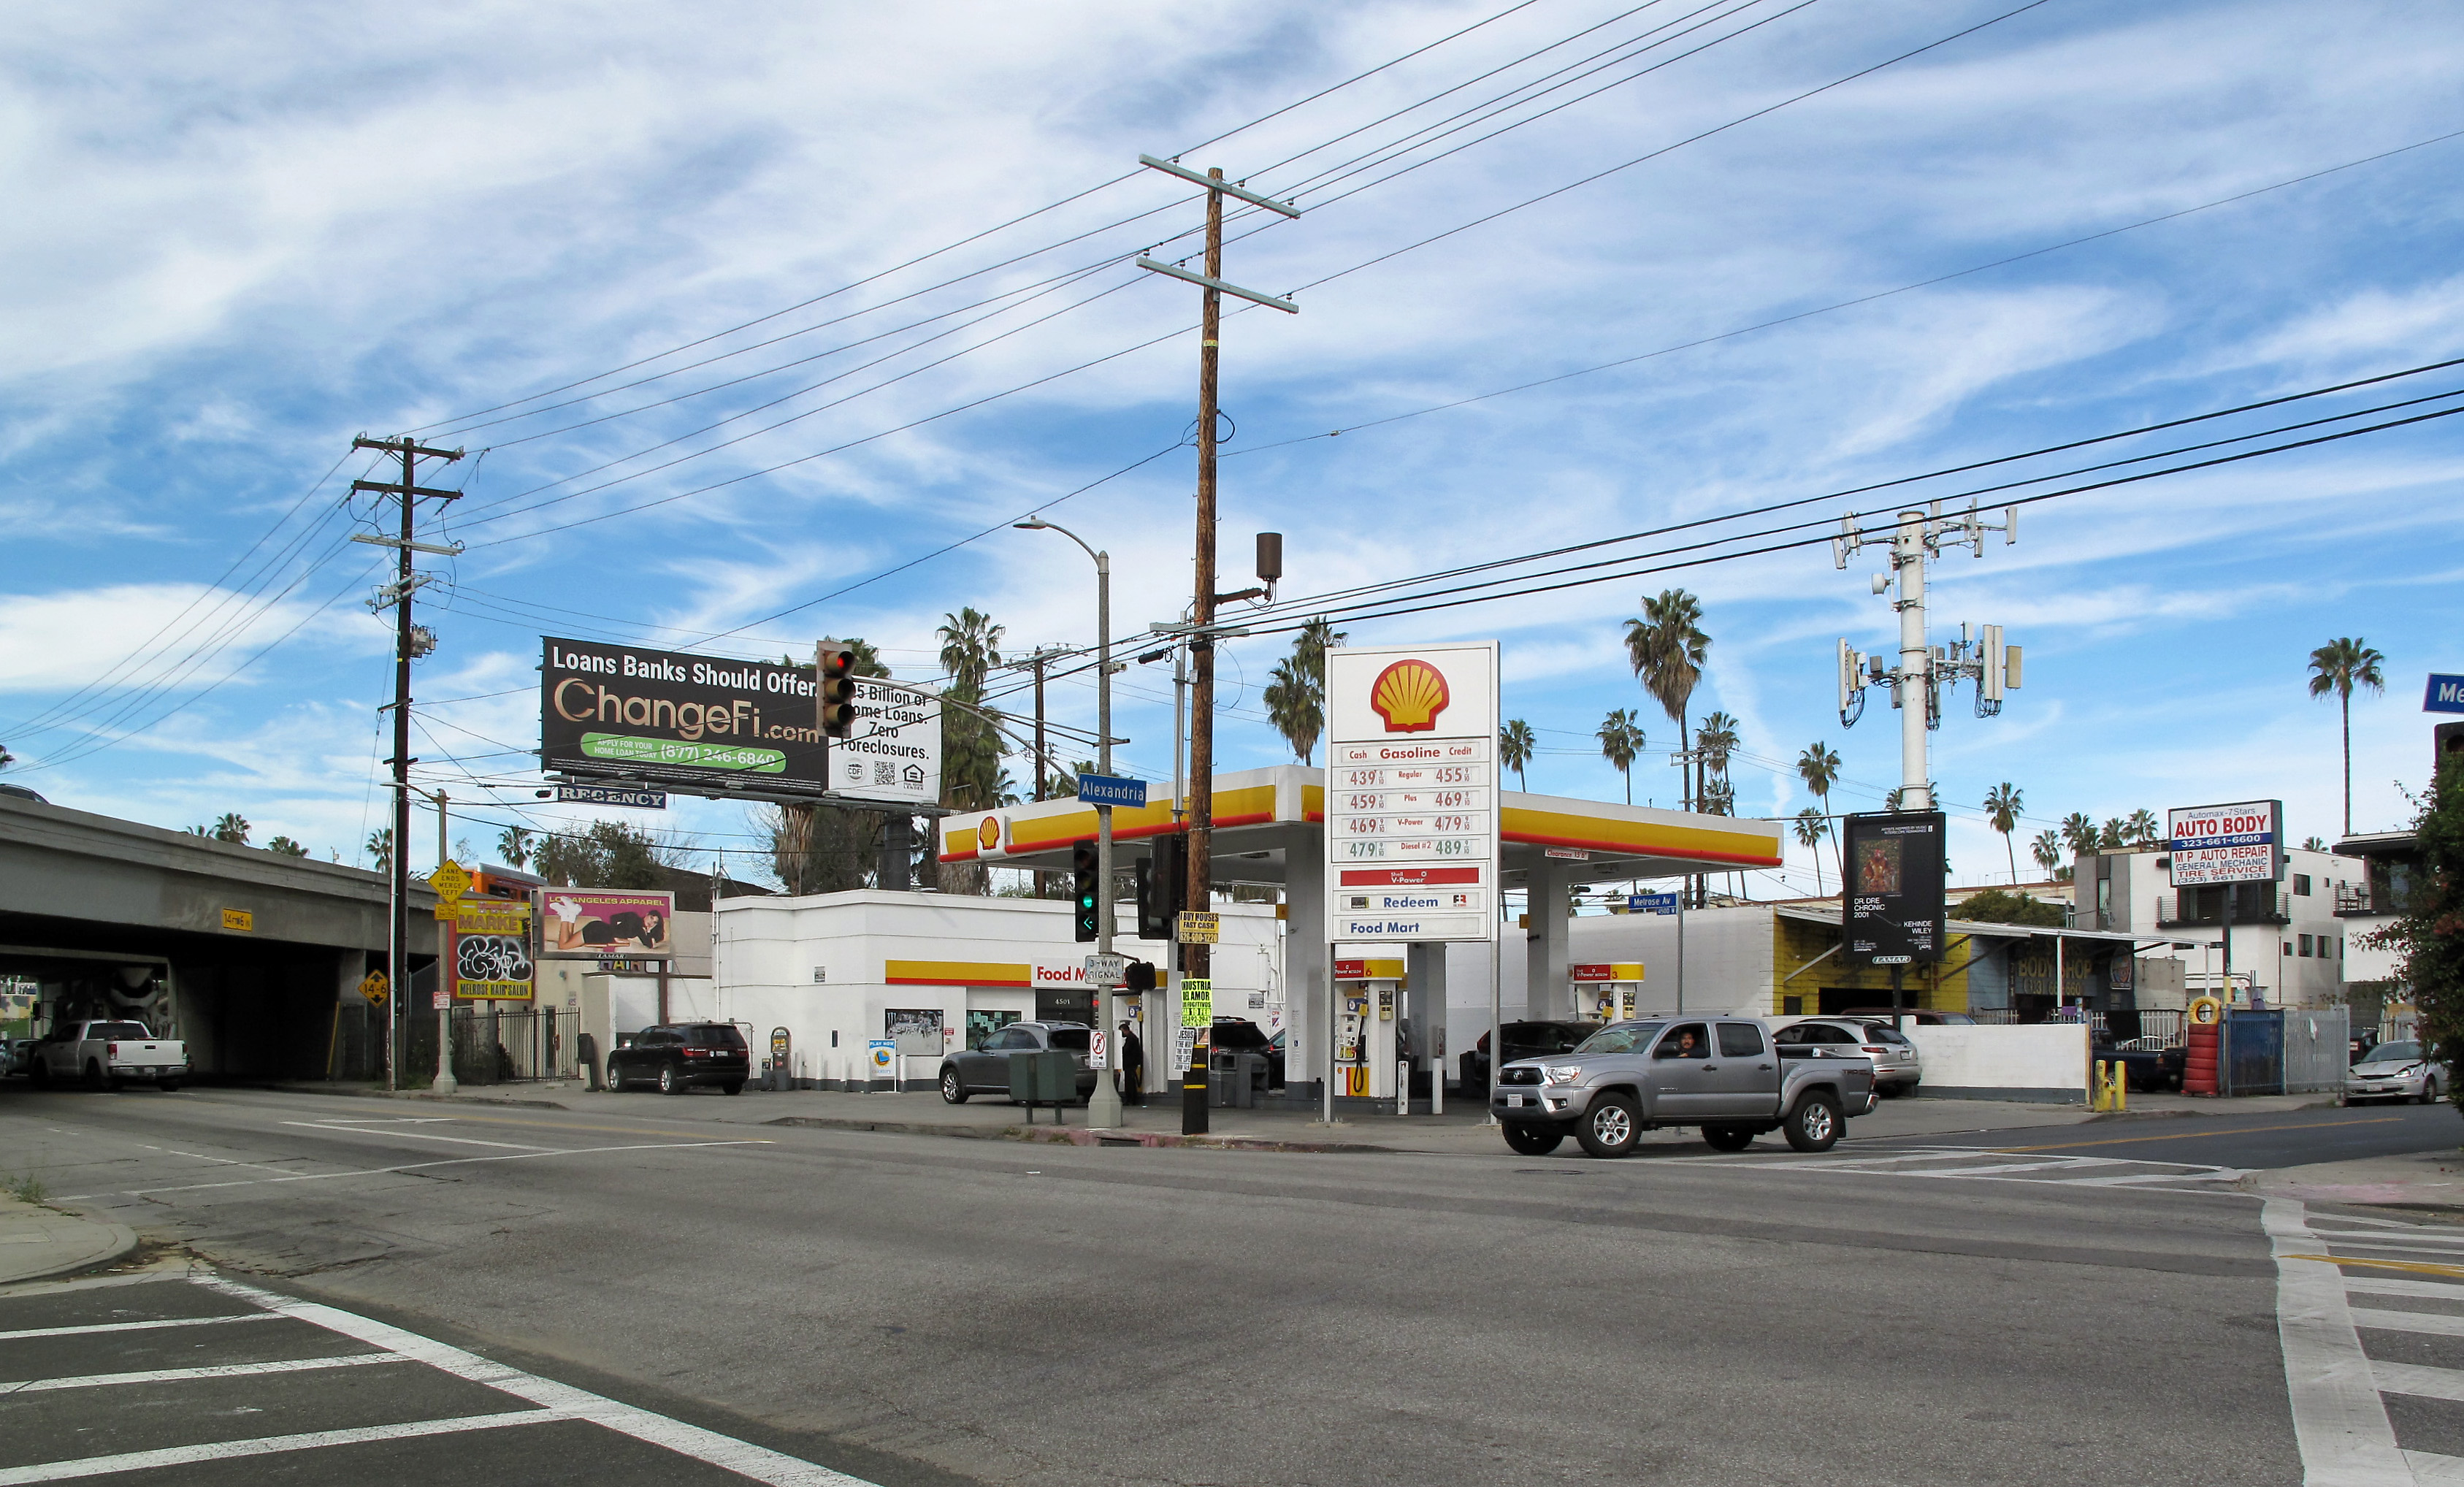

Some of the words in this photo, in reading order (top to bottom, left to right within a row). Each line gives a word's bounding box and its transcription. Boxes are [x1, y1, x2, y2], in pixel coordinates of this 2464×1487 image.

[553, 646, 616, 675] Loans
[624, 654, 686, 683] Banks
[692, 662, 760, 691] Should
[869, 686, 910, 705] Billion
[554, 677, 819, 744] ChangeFi.com
[853, 705, 881, 719] ome
[885, 706, 927, 725] Loans.
[869, 721, 899, 738] Zero
[597, 738, 619, 747] APPLY
[620, 740, 633, 748] FOR
[635, 741, 653, 750] YOUR
[841, 737, 930, 760] Foreclosures.
[594, 746, 614, 755] HOME
[616, 747, 635, 757] LOAN
[635, 749, 657, 759] TODAY
[661, 743, 699, 762] (877)
[703, 748, 776, 767] 246-6840
[1349, 750, 1367, 759] Cash
[1380, 746, 1441, 759] Gasoline
[1449, 746, 1472, 755] Credit
[848, 768, 863, 776] CDFI
[1350, 771, 1376, 785] 439
[1398, 770, 1422, 779] Regular
[1436, 768, 1462, 782] 455
[561, 787, 664, 806] REGENCY
[1082, 781, 1144, 800] Alexandria
[1350, 795, 1376, 809] 459
[1435, 792, 1461, 806] 469
[1350, 819, 1377, 833] 469
[1435, 816, 1461, 830] 479
[2175, 819, 2217, 838] AUTO
[2223, 814, 2268, 834] BODY
[2181, 835, 2261, 847] 323-661-6600
[1350, 843, 1375, 857] 479
[1422, 841, 1431, 849] #2
[1436, 840, 1461, 855] 489
[1547, 849, 1572, 857] Clearance
[2175, 853, 2183, 863] M
[2187, 852, 2193, 862] P
[2200, 849, 2227, 861] AUTO
[2232, 845, 2268, 859] REPAIR
[2176, 862, 2217, 871] GENERAL
[2220, 857, 2268, 868] MECHANIC
[2211, 865, 2267, 876] SERVICE
[2177, 877, 2206, 885] (323)
[619, 898, 665, 906] APPAREL
[1384, 897, 1438, 907] Redeem
[1634, 898, 1660, 906] Melrose
[1662, 897, 1671, 905] Av
[1853, 903, 1886, 911] CHRONIC
[459, 914, 524, 931] MARKE
[1183, 912, 1194, 921] BUY
[1195, 913, 1219, 922] HOUSES
[1351, 922, 1382, 933] Food
[1387, 922, 1419, 933] Mart
[1090, 960, 1119, 968] 3-WAY
[2018, 957, 2054, 977] BODY
[1037, 966, 1071, 981] Food
[1366, 968, 1371, 976] 6
[460, 984, 489, 995] MELROSE
[491, 985, 507, 995] HAIR
[508, 985, 529, 996] SALON
[1182, 981, 1211, 990] INDUSTRIA
[1191, 991, 1209, 1001] AMOR
[1178, 1030, 1193, 1039] JESUS
